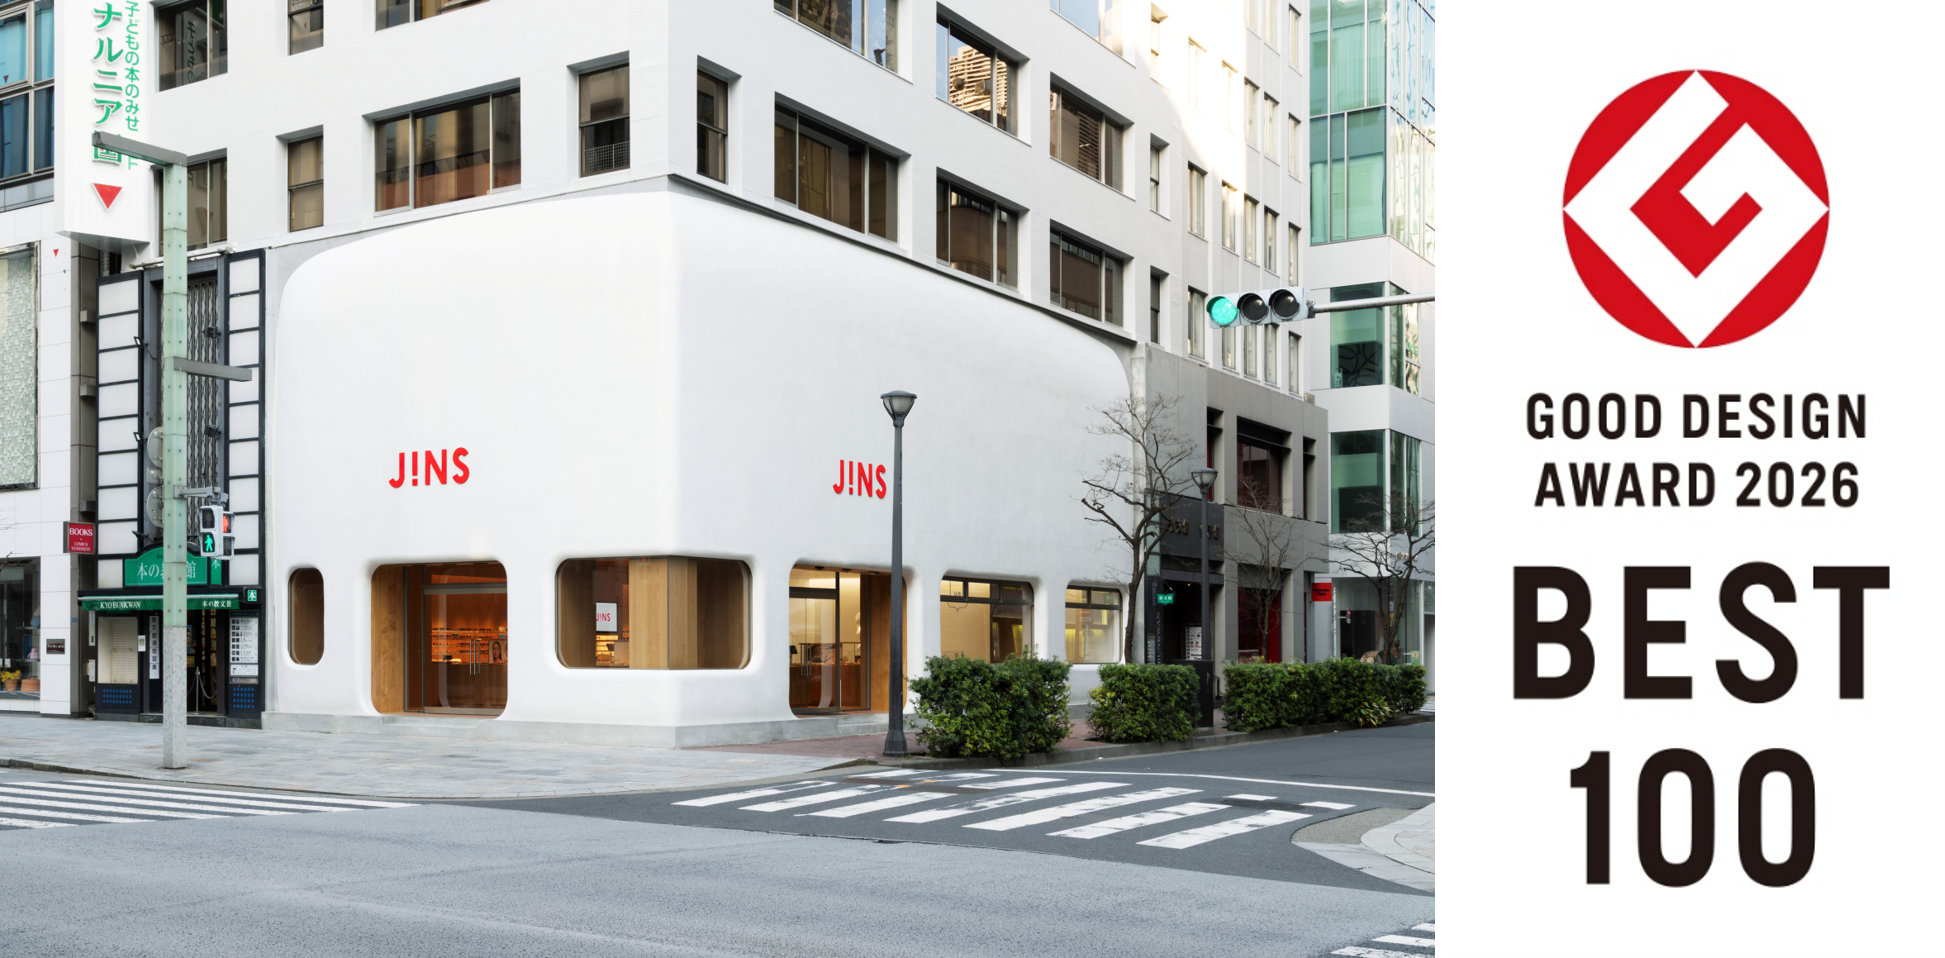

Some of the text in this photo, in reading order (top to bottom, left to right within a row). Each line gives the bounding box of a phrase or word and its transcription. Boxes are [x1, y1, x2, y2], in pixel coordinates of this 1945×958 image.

[125, 1, 140, 132] 子どもの本のみせ
[69, 527, 94, 537] BOOKS
[137, 561, 196, 580] 本の館
